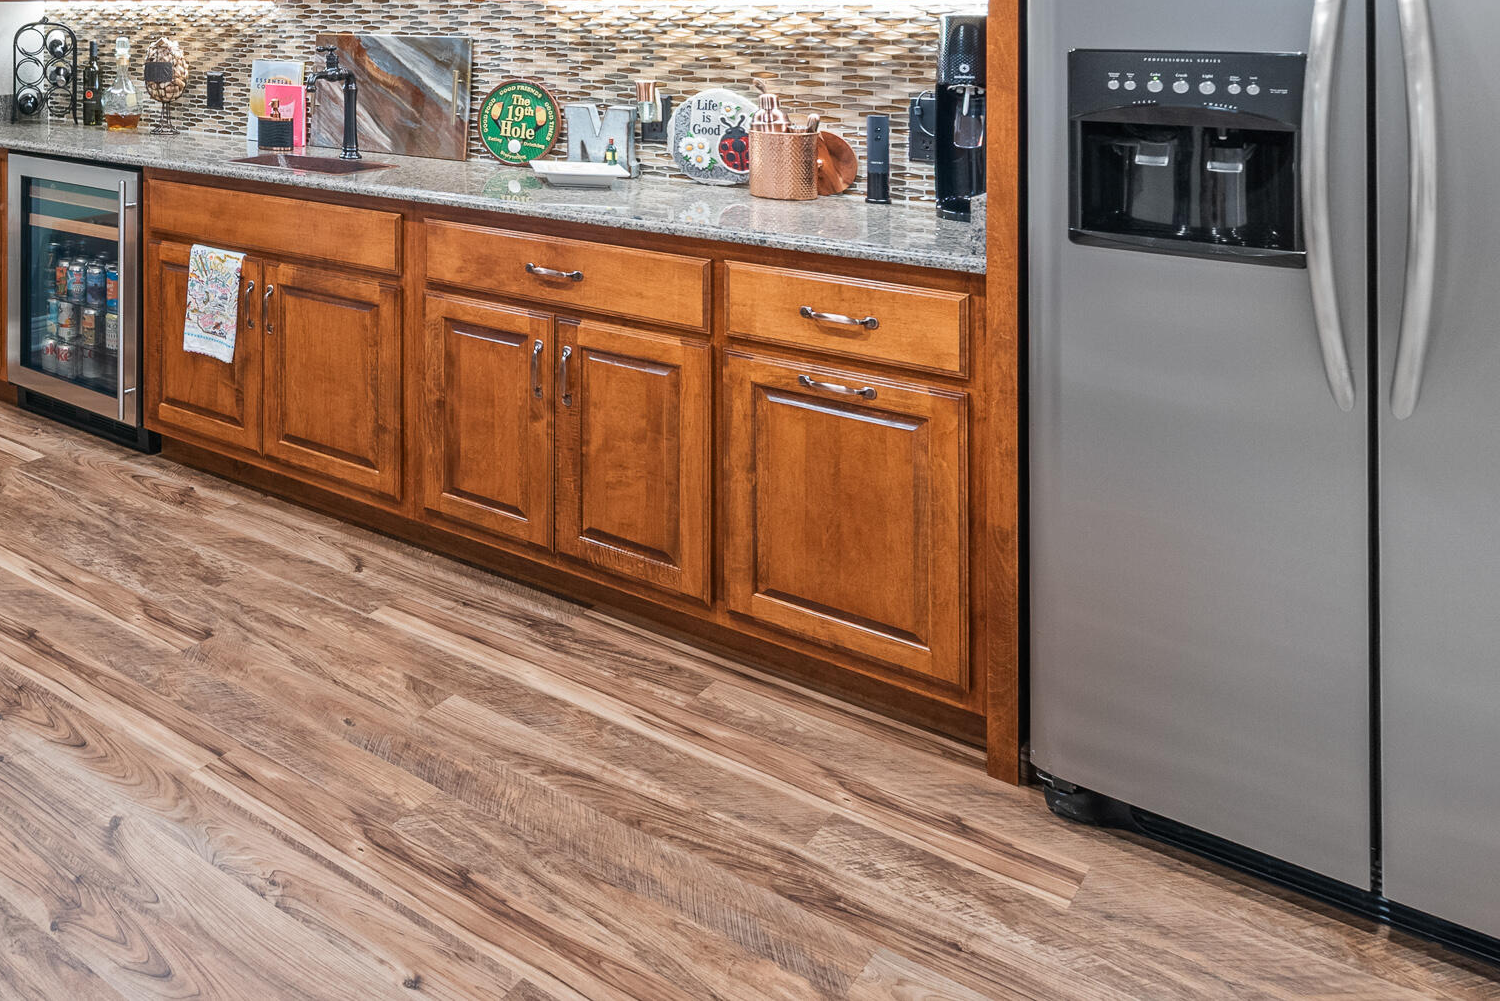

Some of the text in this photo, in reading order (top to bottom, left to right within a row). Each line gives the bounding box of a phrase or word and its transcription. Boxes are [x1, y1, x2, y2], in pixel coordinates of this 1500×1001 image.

[255, 77, 292, 85] ESSENTIAL
[499, 85, 543, 98] GOOD FRIENDS
[512, 94, 531, 106] The
[696, 99, 718, 111] Life
[505, 105, 534, 122] 19th
[544, 101, 554, 120] GOOD
[702, 111, 712, 123] is
[499, 120, 535, 140] Hole
[692, 123, 721, 136] Good
